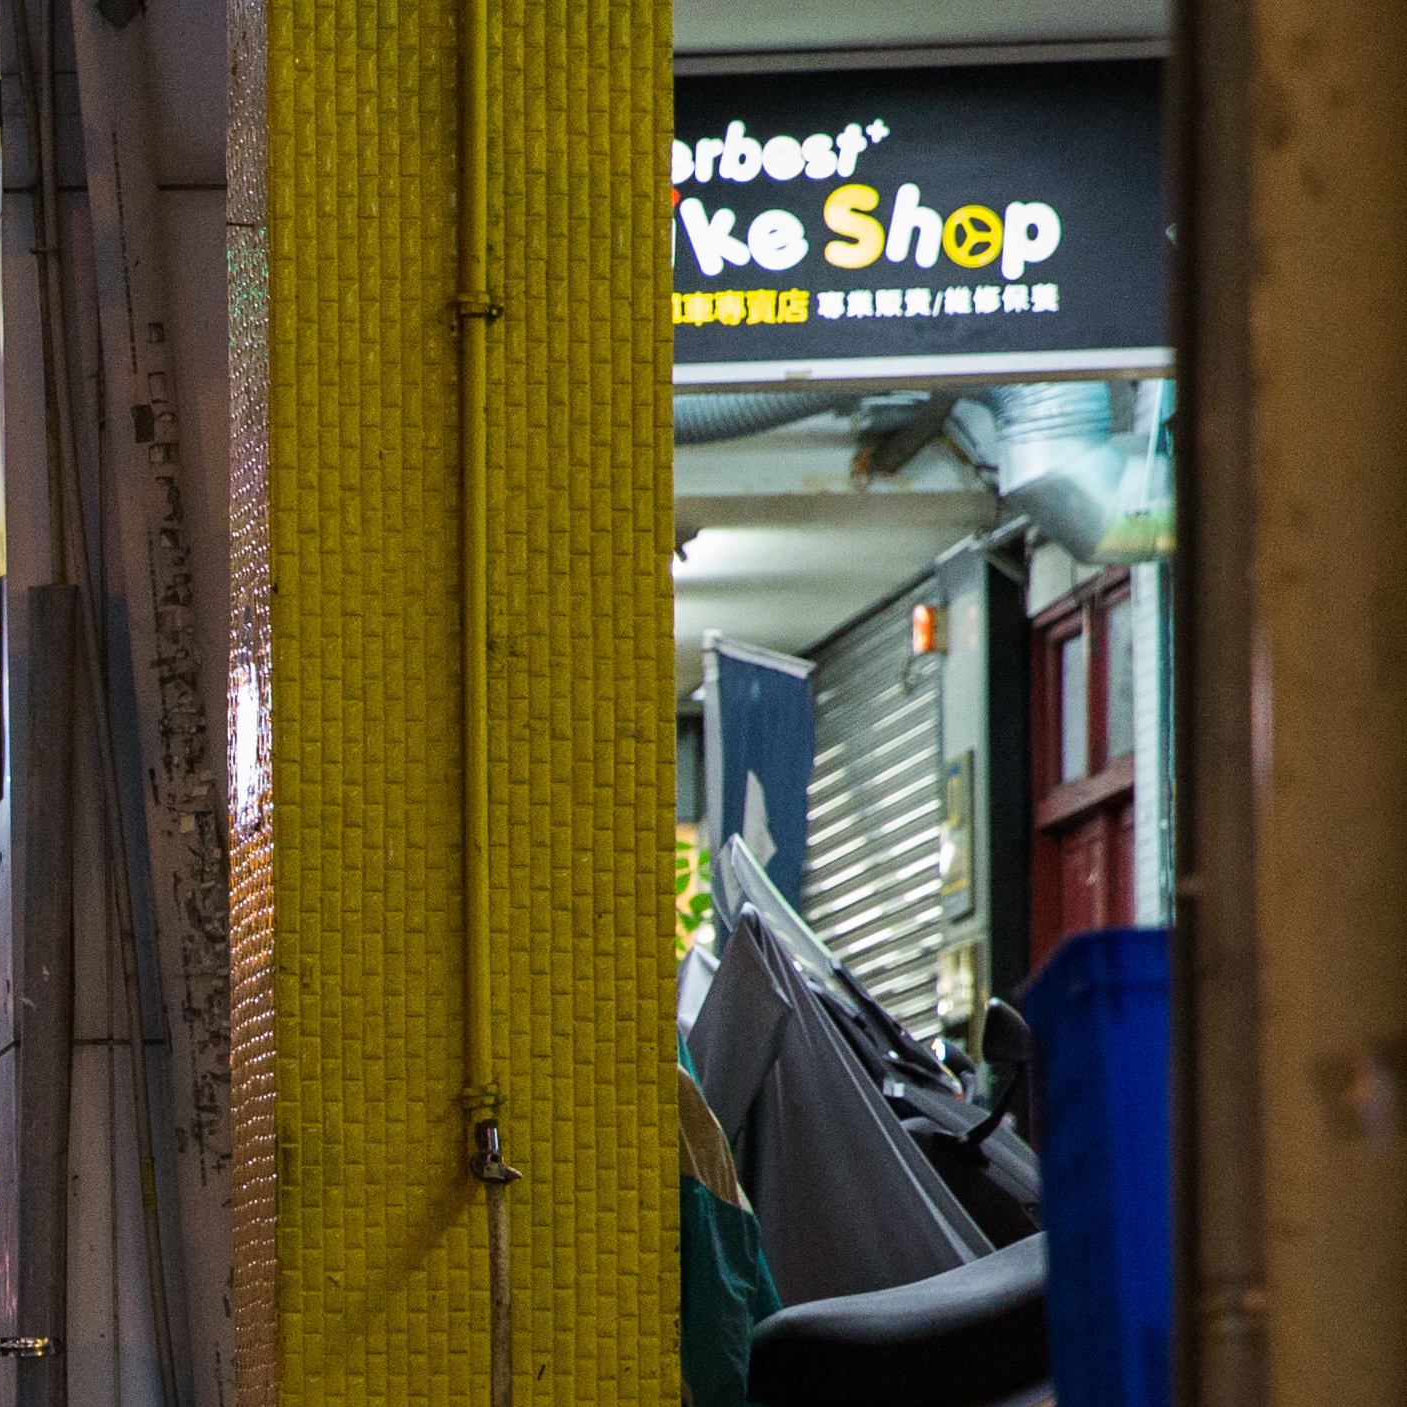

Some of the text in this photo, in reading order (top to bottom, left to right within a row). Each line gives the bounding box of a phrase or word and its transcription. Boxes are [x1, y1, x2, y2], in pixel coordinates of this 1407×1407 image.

[672, 183, 1061, 280] ke Shop
[672, 288, 809, 326] 車專賣店
